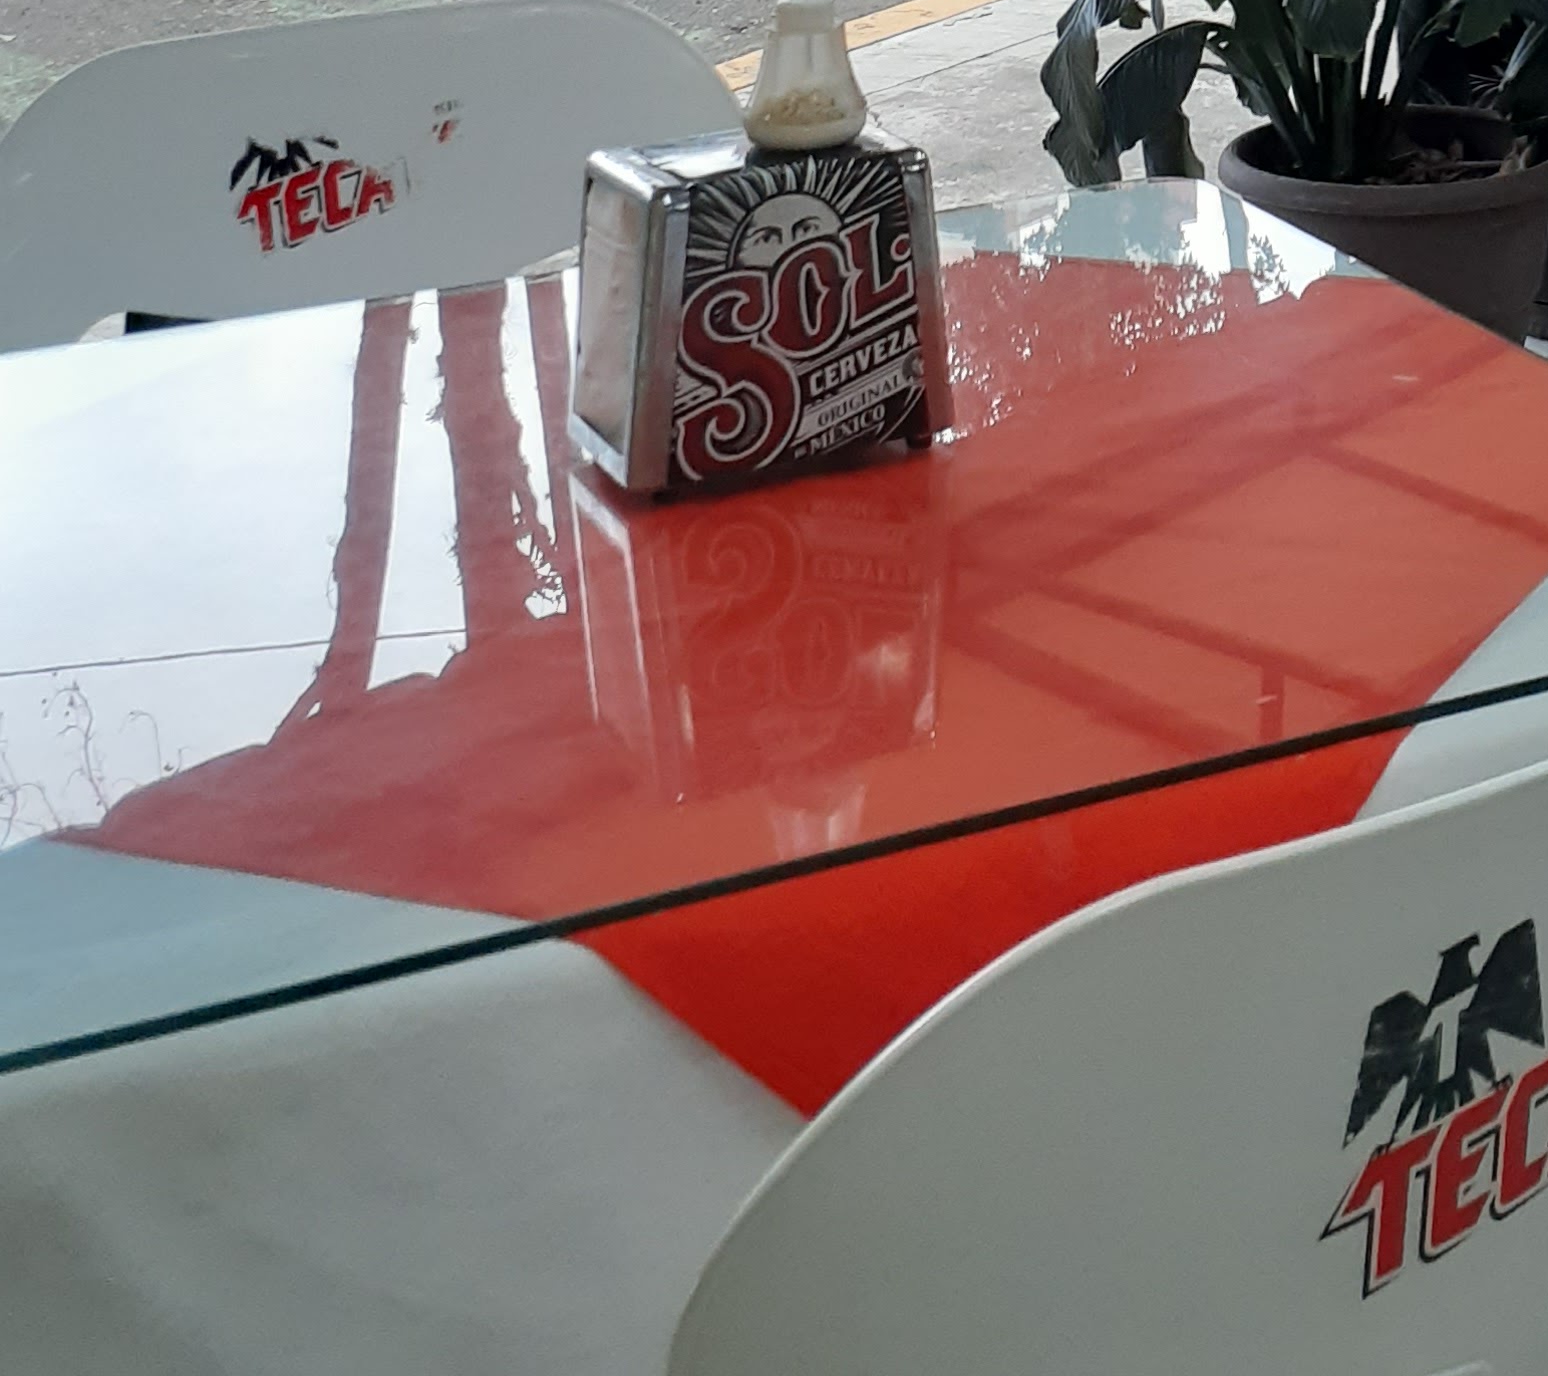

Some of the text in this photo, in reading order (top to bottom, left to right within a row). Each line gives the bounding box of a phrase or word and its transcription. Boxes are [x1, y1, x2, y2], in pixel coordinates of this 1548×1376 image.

[237, 158, 411, 253] TECA
[676, 212, 916, 481] SOL
[808, 323, 918, 395] CERVEZA
[817, 374, 902, 429] ORIGINAL
